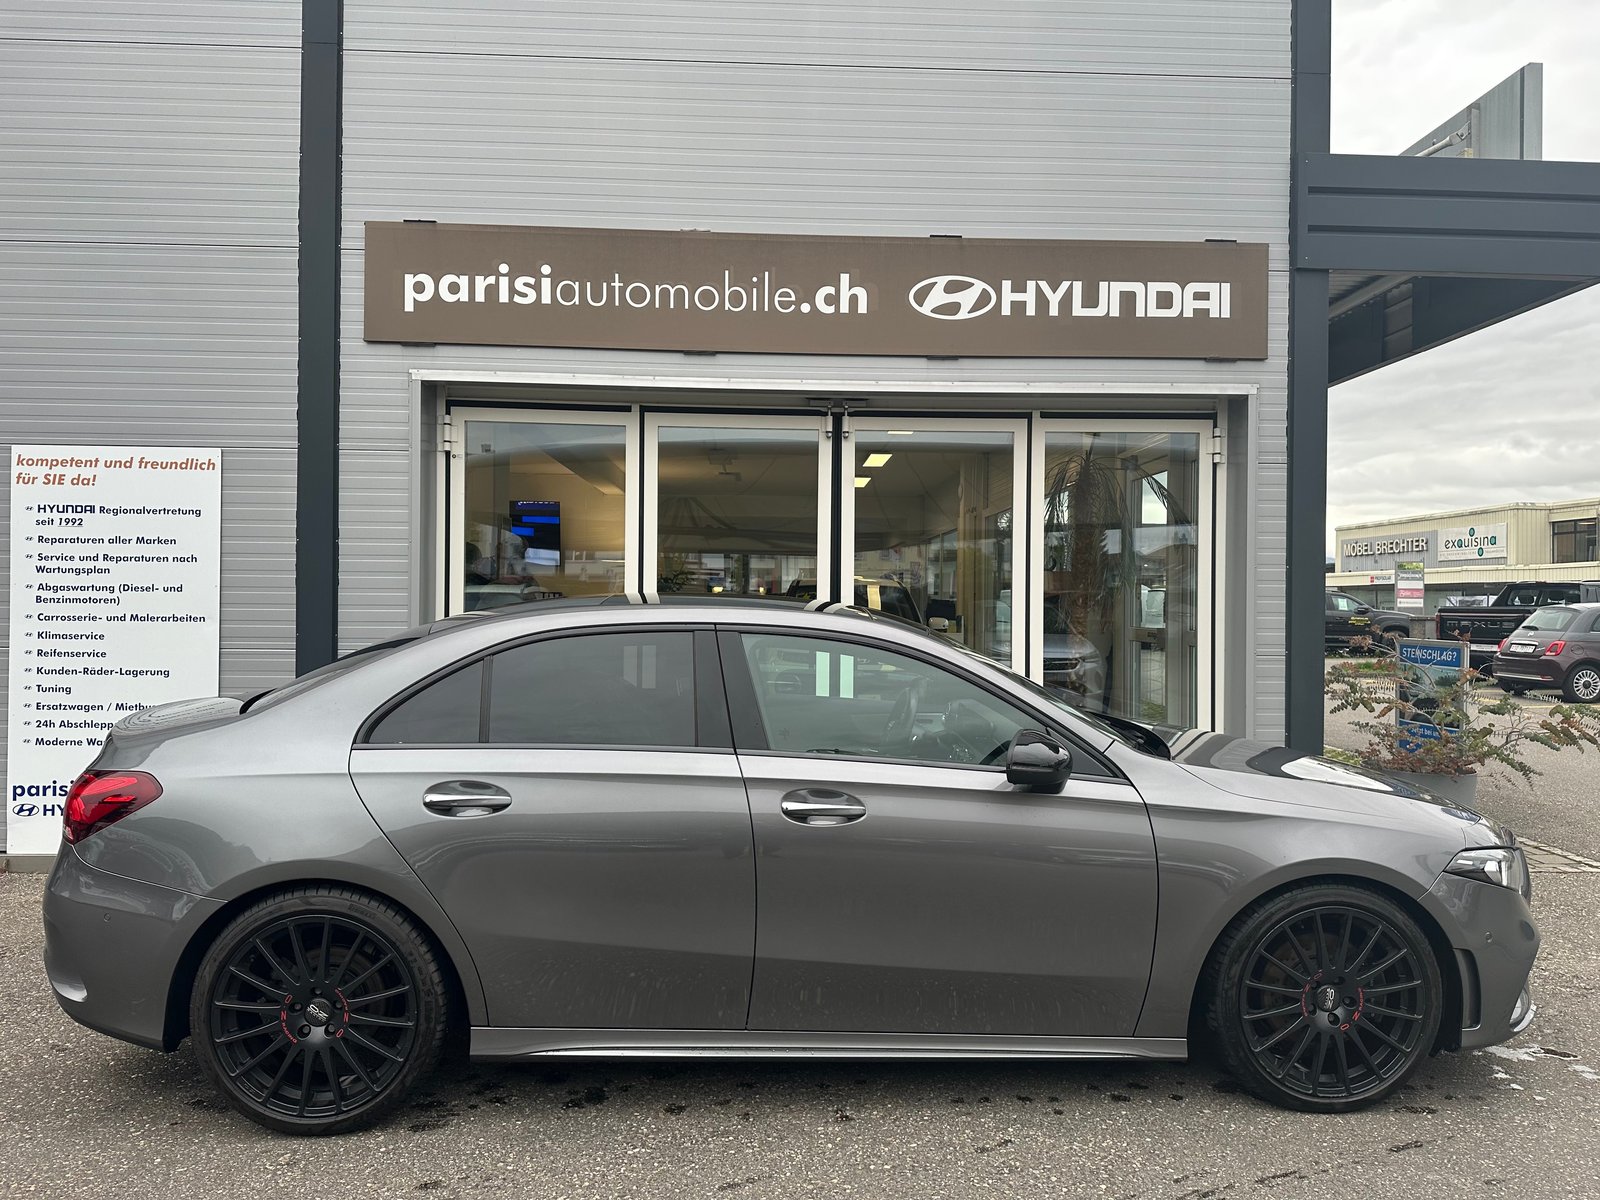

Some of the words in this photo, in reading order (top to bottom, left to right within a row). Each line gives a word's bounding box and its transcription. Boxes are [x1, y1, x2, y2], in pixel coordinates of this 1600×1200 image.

[403, 263, 868, 314] parisiautomobile.ch
[1001, 280, 1231, 318] HYUNDAI
[16, 454, 99, 470] kompetent
[104, 456, 133, 468] und
[138, 457, 216, 471] freundlich
[15, 472, 38, 485] für
[42, 473, 66, 486] SIE
[70, 474, 97, 487] da!
[37, 504, 96, 514] HYUNDAI
[99, 505, 202, 517] Regionalvertretung
[35, 517, 55, 526] seit
[57, 517, 84, 527] 1992
[37, 535, 105, 546] Reparaturen
[107, 535, 133, 545] aller
[135, 536, 177, 546] Marken
[1344, 540, 1374, 557] MÖBEL
[1375, 537, 1428, 555] BRECHTER
[37, 552, 76, 562] Service
[78, 552, 99, 562] und
[102, 553, 169, 564] Reparaturen
[172, 554, 198, 563] nach
[35, 565, 111, 576] Wartungsplan
[37, 582, 115, 594] Abgaswartung
[118, 583, 160, 594] (Diesel-
[162, 584, 183, 593] und
[35, 595, 121, 607] Benzinmotoren)
[37, 613, 103, 622] Carrosserie-
[106, 613, 127, 622] und
[129, 613, 206, 623] Malerarbeiten
[37, 631, 105, 641] Klimaservice
[36, 649, 107, 659] Reifenservice
[1402, 647, 1457, 662] STEINSCHLAG?
[36, 666, 170, 678] Kunden-Räder-Lagerung
[35, 684, 72, 695] Tuning
[35, 702, 104, 713] Ersatzwagen
[106, 702, 112, 712] /
[35, 719, 56, 729] 24h
[35, 737, 84, 747] Moderne
